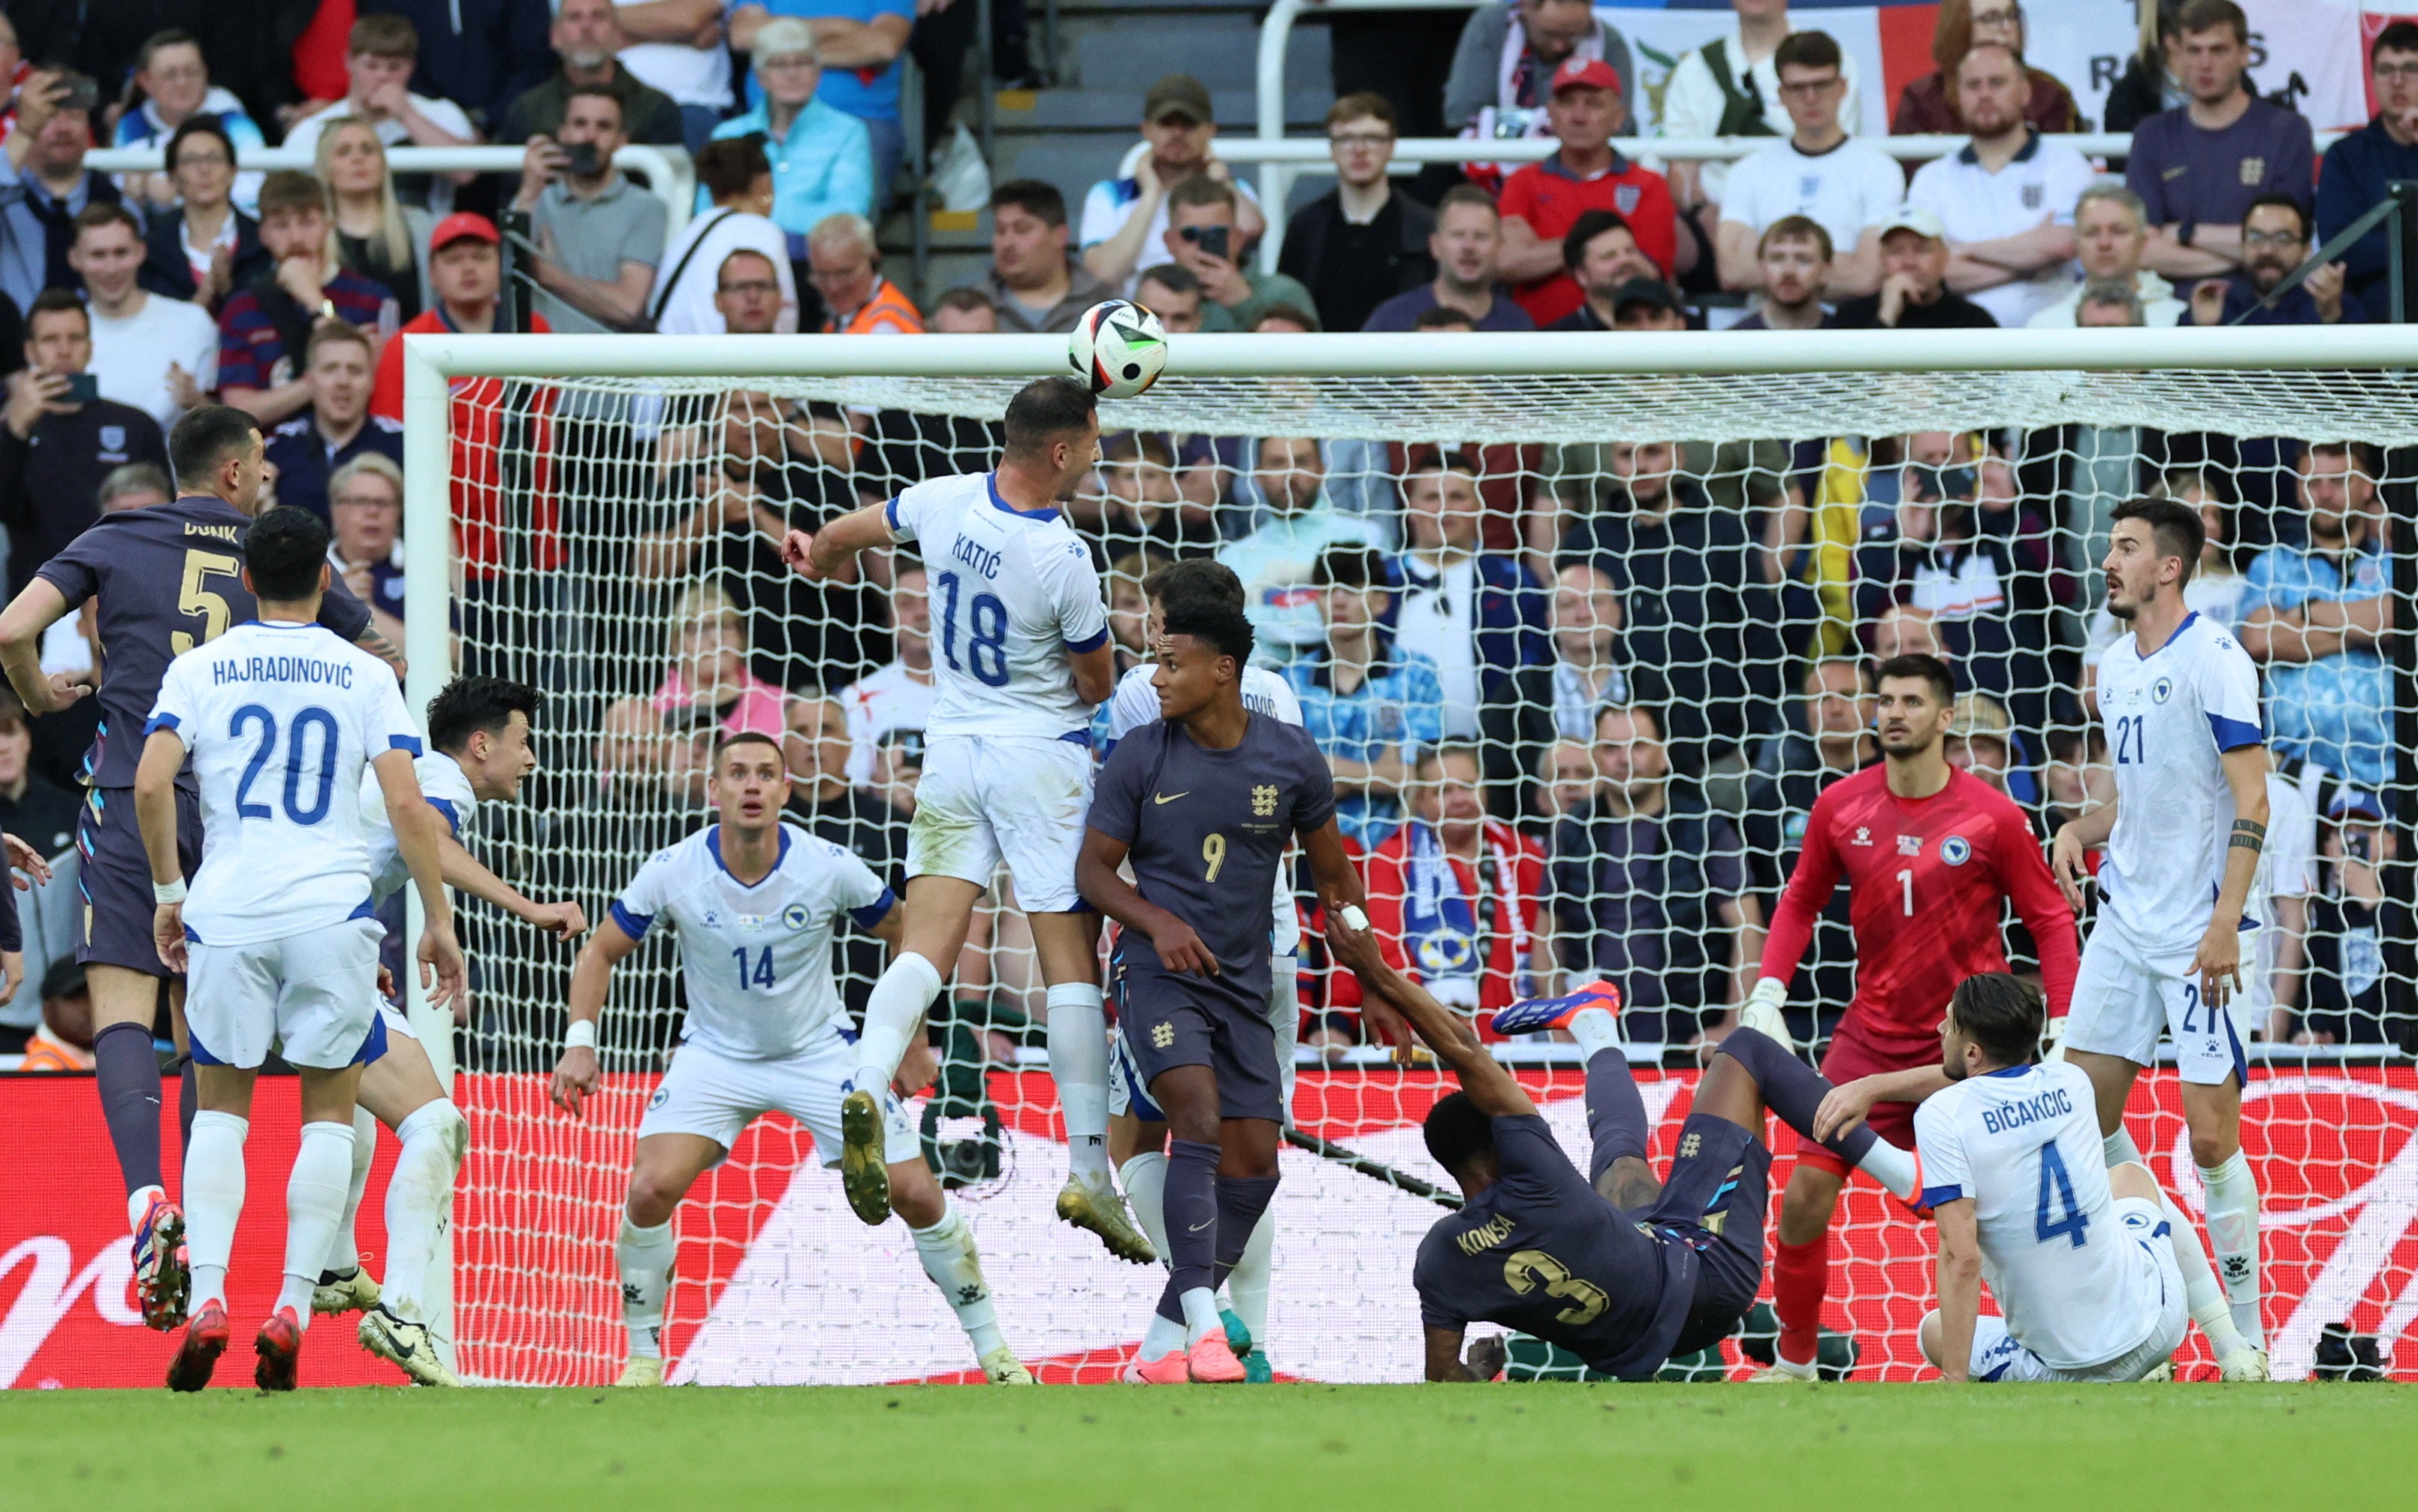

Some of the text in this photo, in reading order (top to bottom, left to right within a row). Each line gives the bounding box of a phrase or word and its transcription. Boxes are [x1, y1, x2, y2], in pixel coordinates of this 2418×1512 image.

[952, 532, 1002, 580] KATIĆ
[171, 548, 240, 657] 5
[937, 569, 1012, 689] 18
[213, 656, 353, 690] HAJRADINOVIĆ
[228, 702, 340, 827] 20
[2117, 714, 2144, 765] 21
[1203, 832, 1226, 883] 9
[1896, 868, 1914, 917] 1
[732, 945, 777, 991] 14
[1982, 1088, 2072, 1135] BIČAKČIC
[2034, 1136, 2091, 1251] 4
[1456, 1212, 1517, 1257] KONSA
[1503, 1249, 1610, 1326] 3
